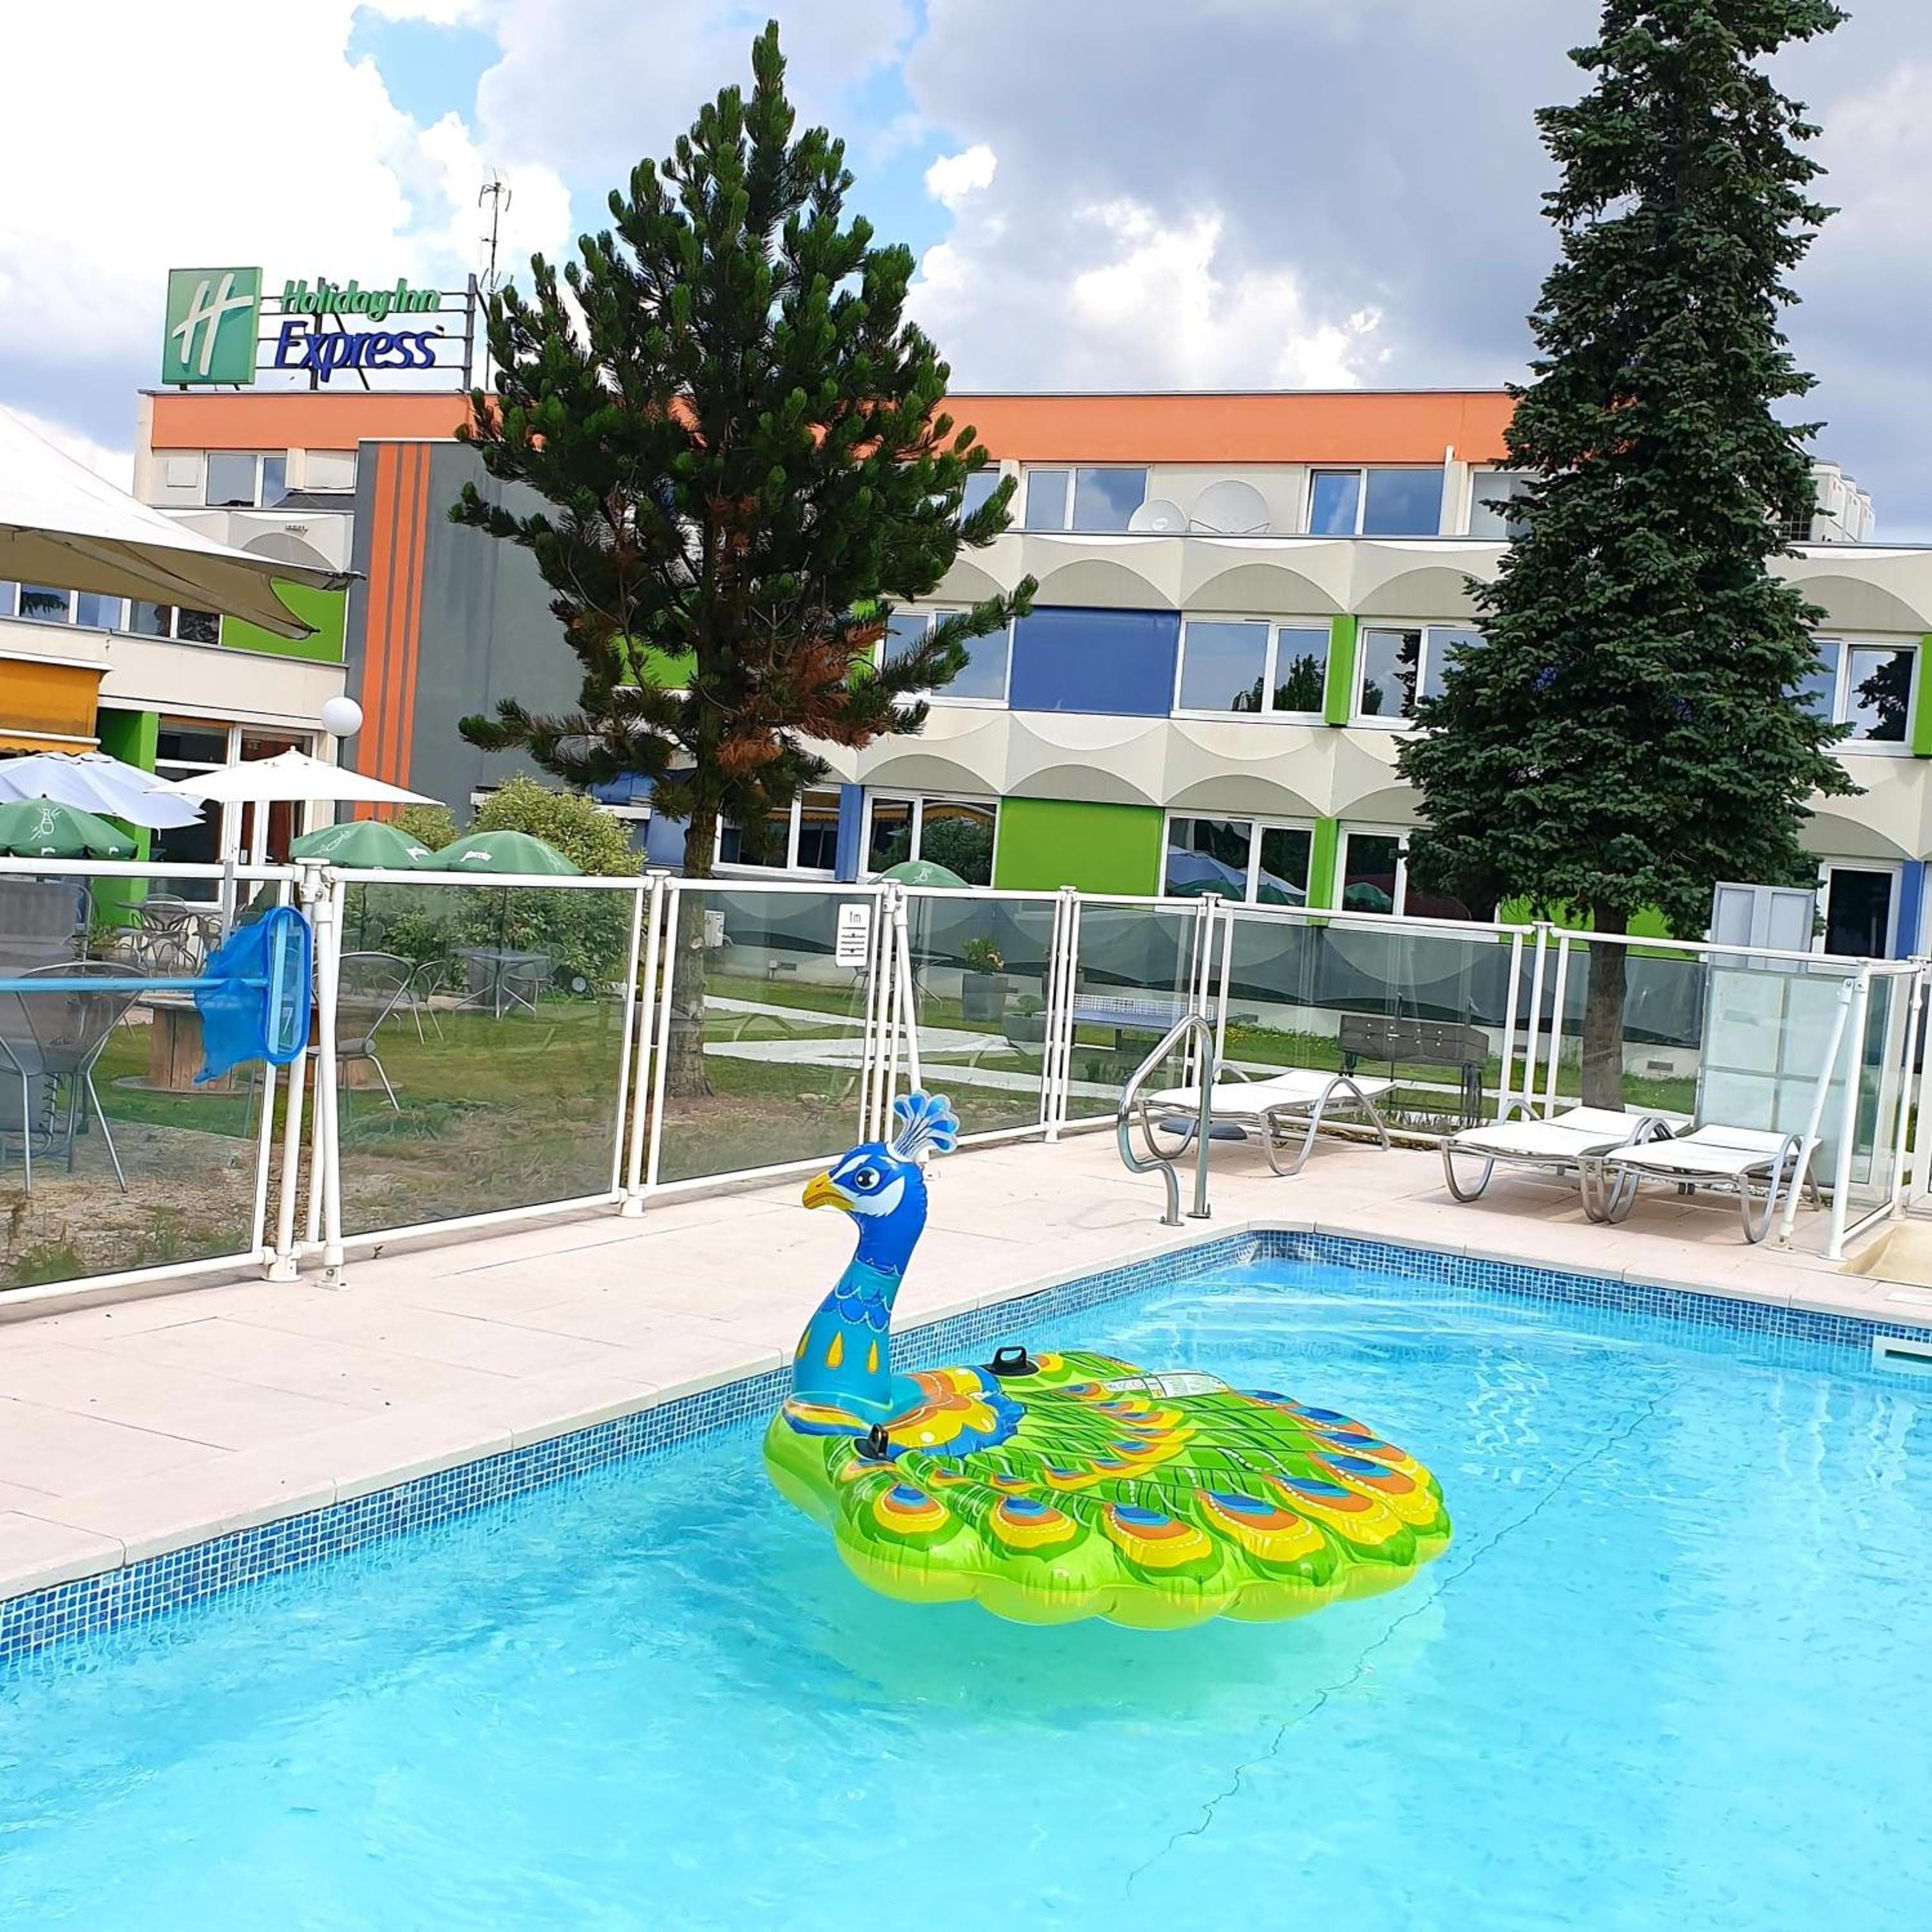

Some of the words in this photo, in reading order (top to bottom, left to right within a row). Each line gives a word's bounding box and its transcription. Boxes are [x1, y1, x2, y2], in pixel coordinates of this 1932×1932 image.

[280, 279, 391, 321] Holiday
[392, 278, 441, 312] Inn
[275, 321, 436, 383] Express
